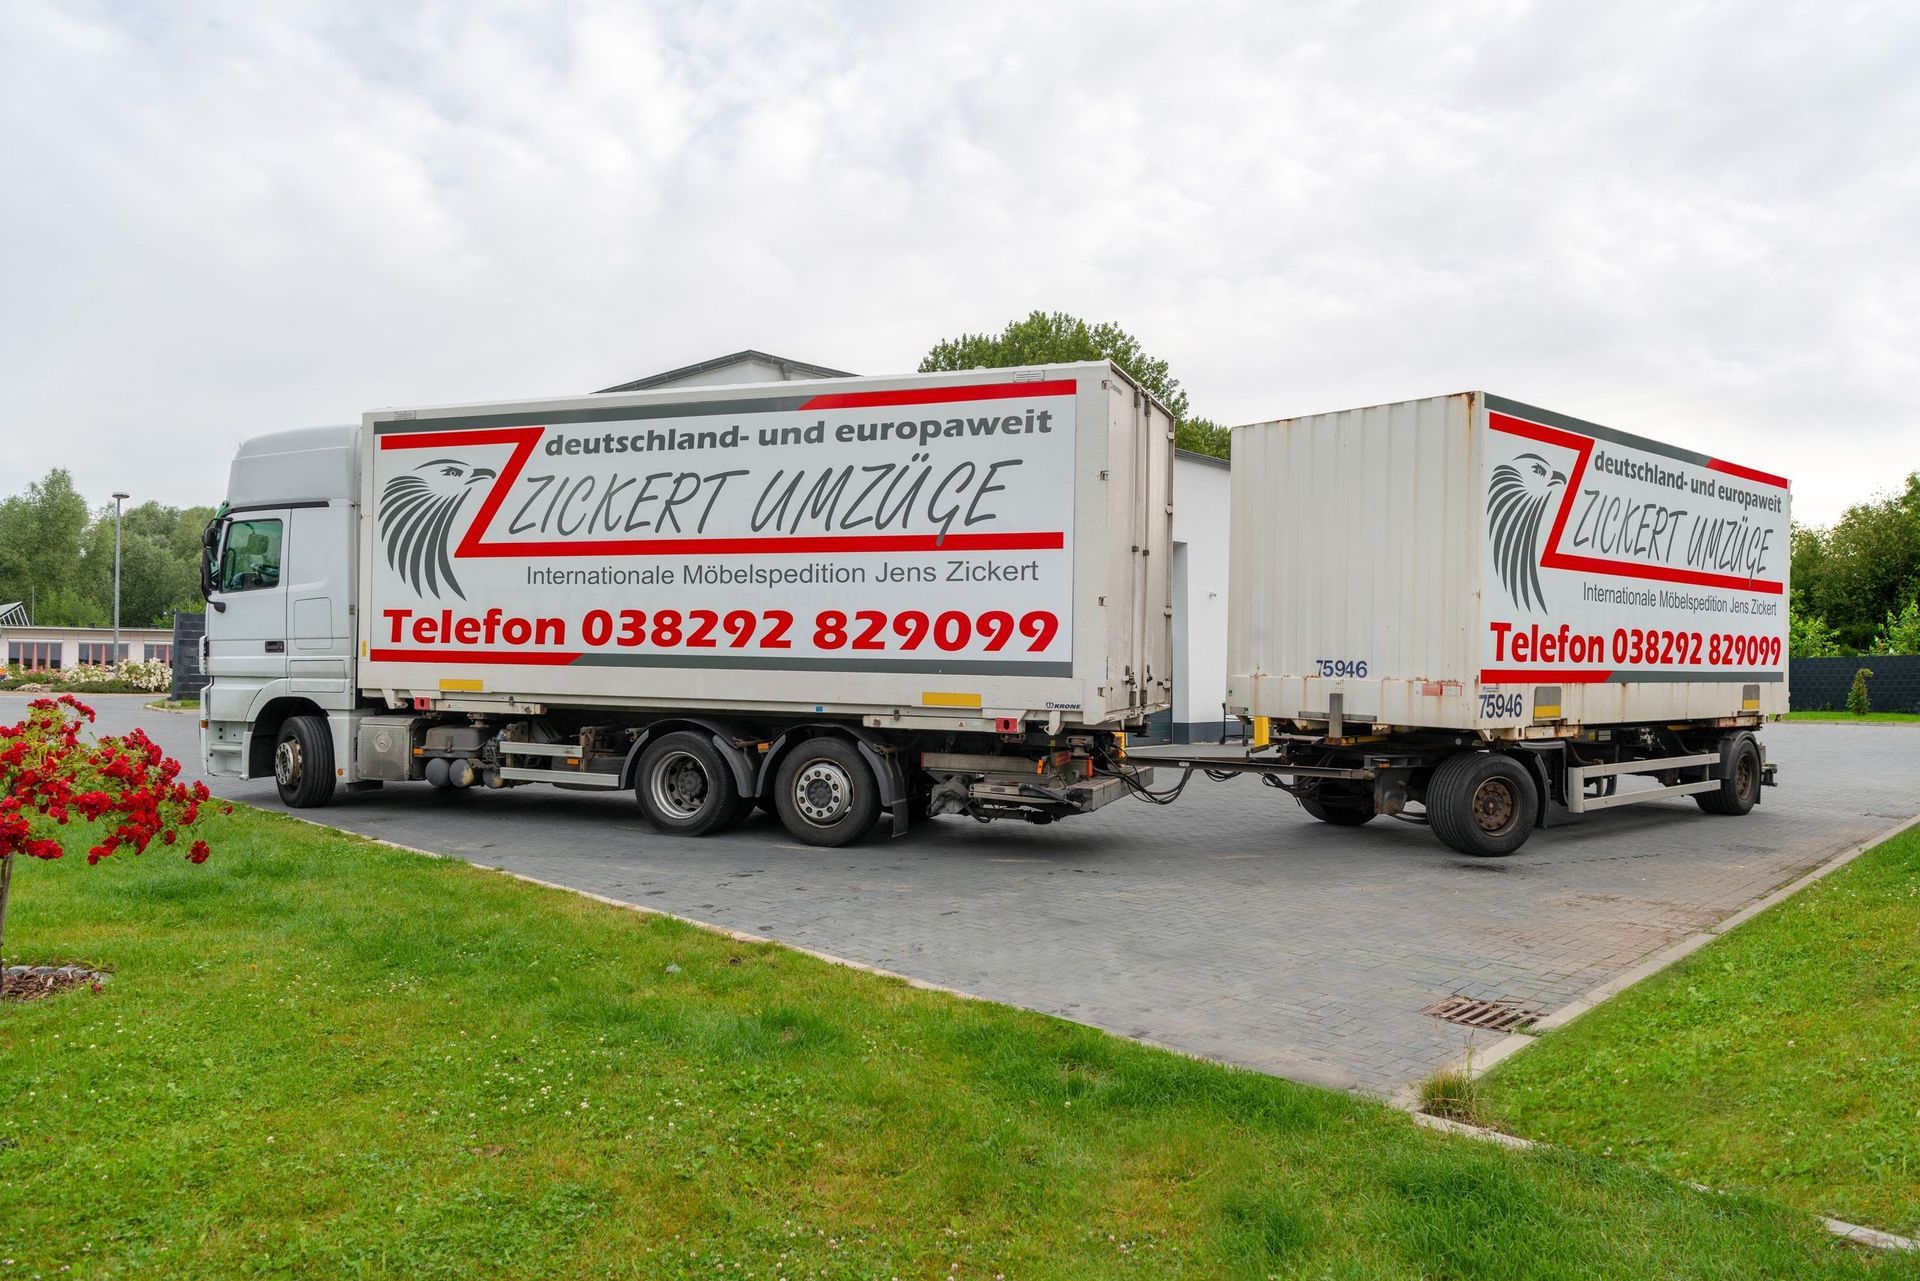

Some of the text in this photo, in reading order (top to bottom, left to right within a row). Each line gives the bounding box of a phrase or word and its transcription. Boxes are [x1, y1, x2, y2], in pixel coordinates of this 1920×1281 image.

[545, 409, 1053, 457] deutschland- und europaweit
[508, 453, 1024, 547] ZICKERT UMZÜGE
[1594, 450, 1783, 514] deutschland- und europaweit
[1573, 488, 1775, 589] ZICKERT UMZÜGE
[527, 560, 1040, 589] Internationale Möbelspedition Jens Zickert
[1583, 581, 1778, 617] Internationale Möbelspedition Jens Zickert
[383, 607, 1060, 654] Telefon 038292 829099
[1490, 621, 1782, 667] Telefon 038292 829099
[1316, 659, 1367, 679] 75946
[1478, 693, 1523, 719] 75946
